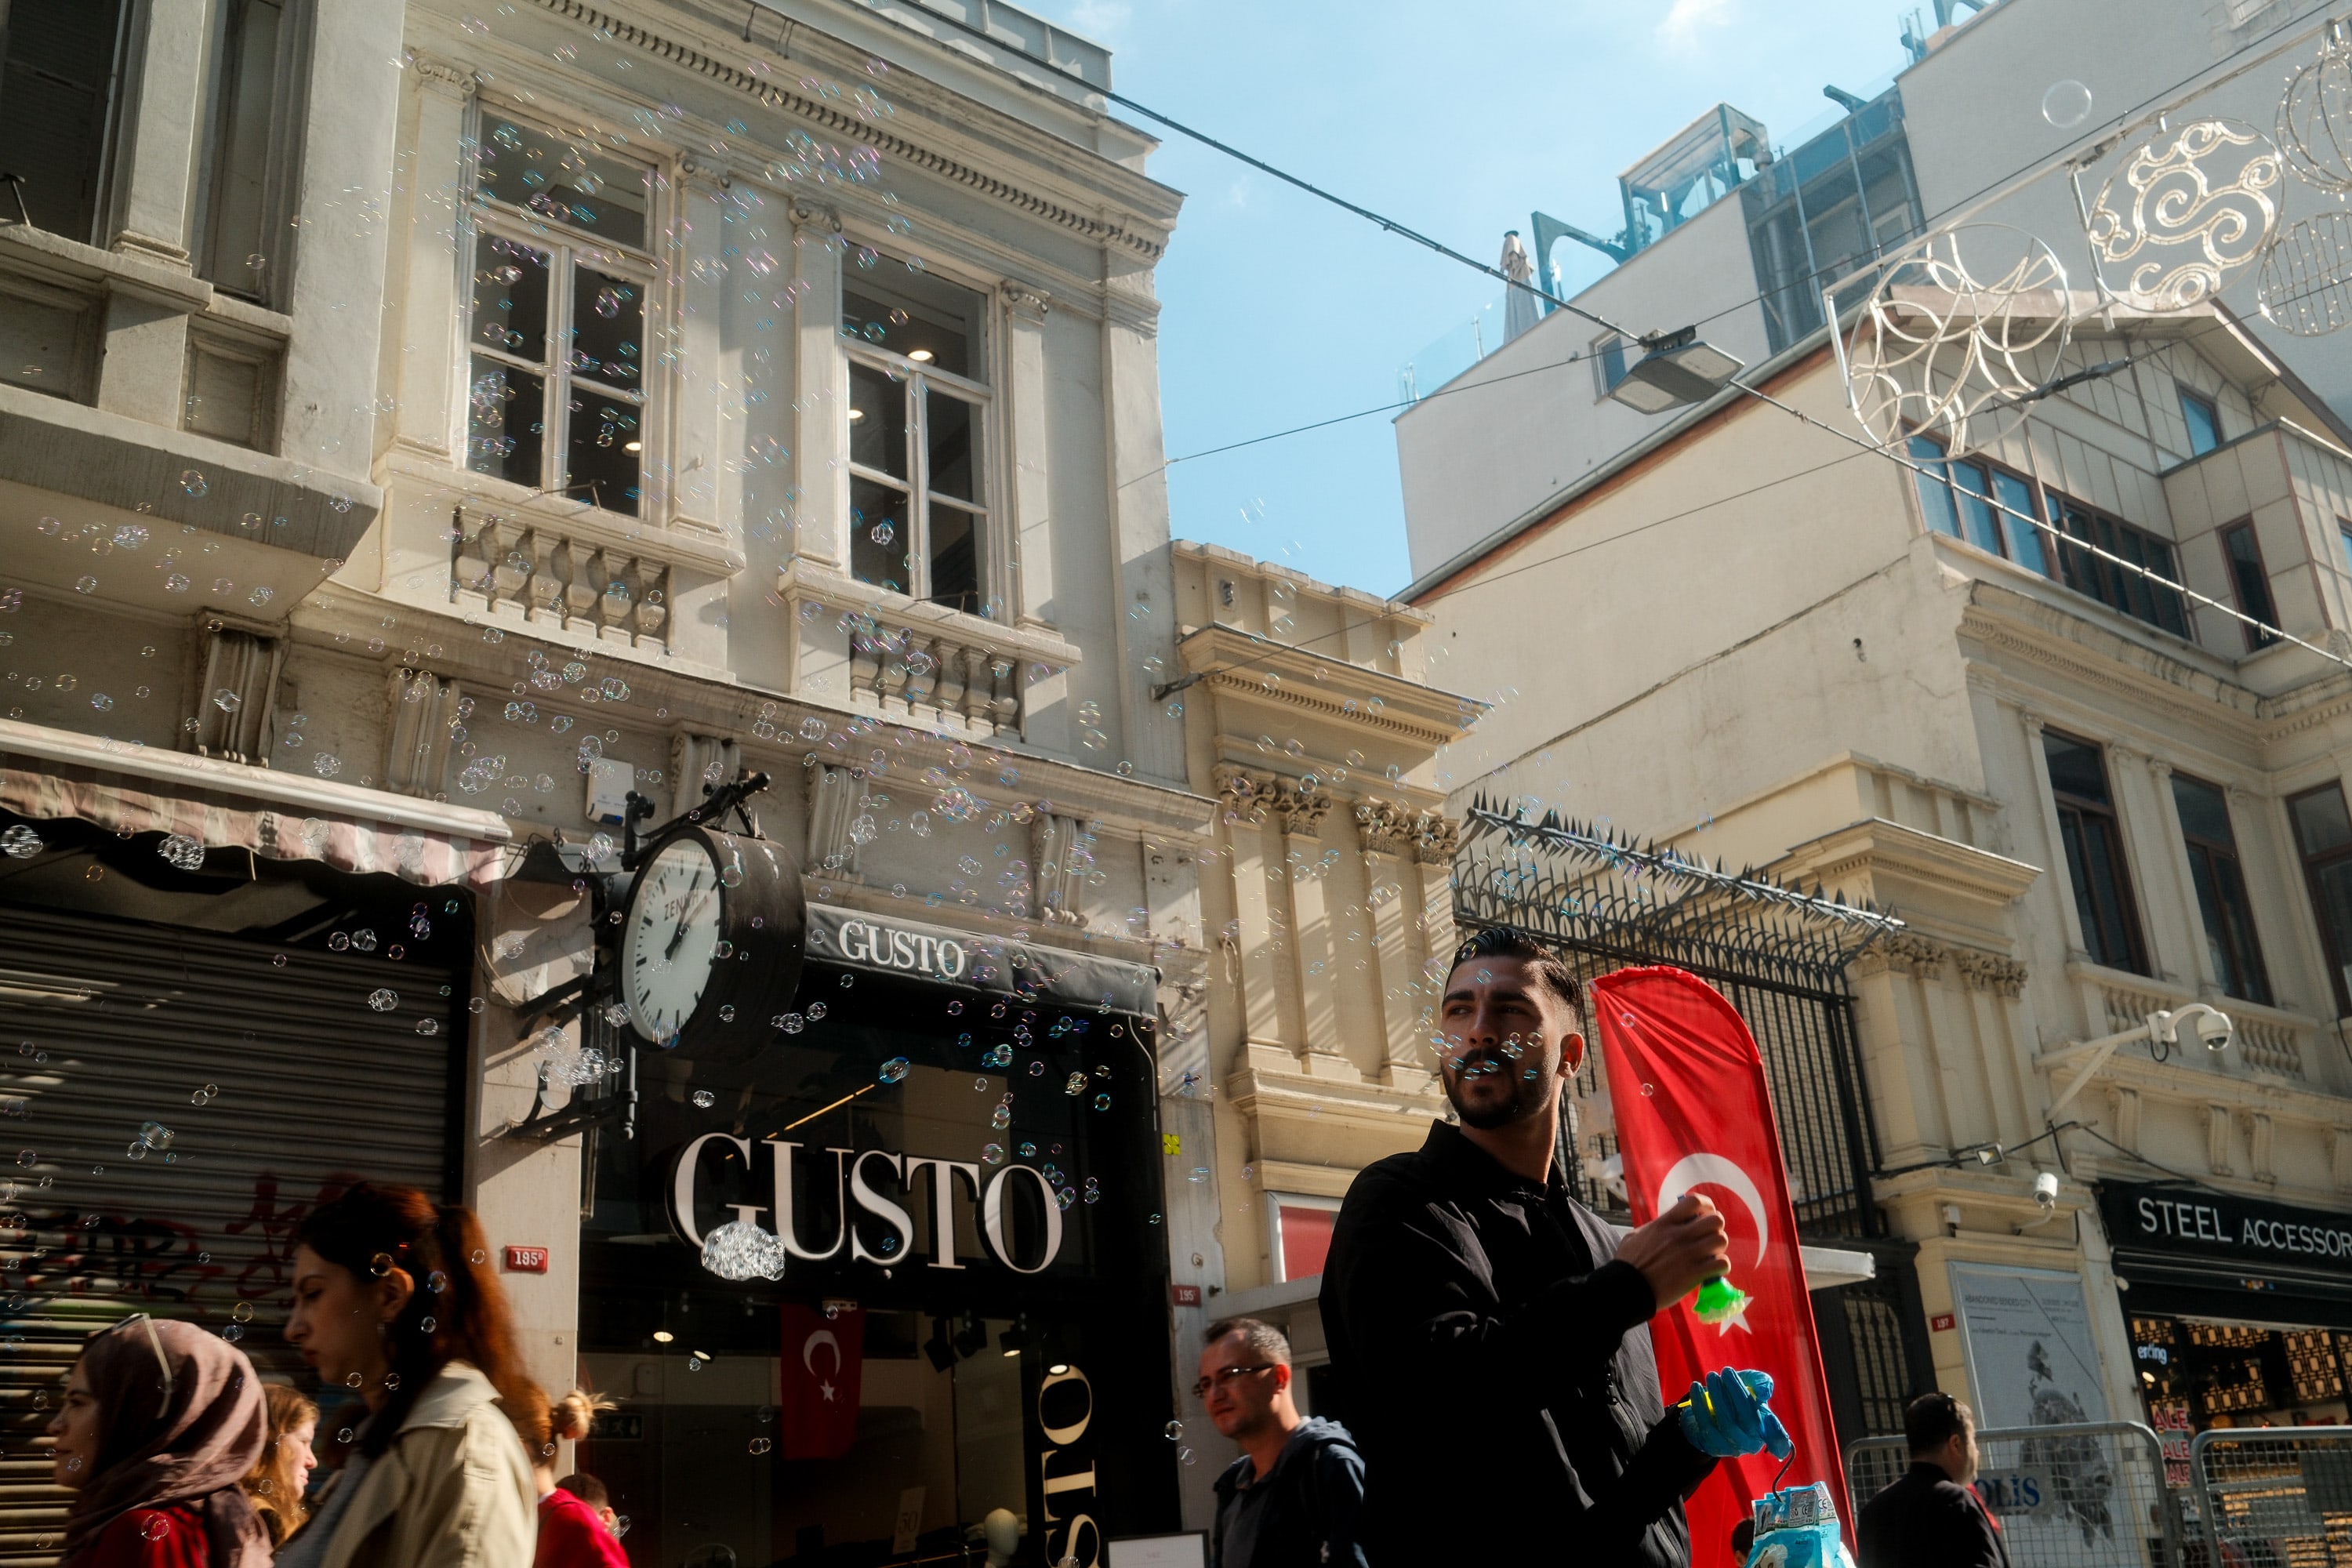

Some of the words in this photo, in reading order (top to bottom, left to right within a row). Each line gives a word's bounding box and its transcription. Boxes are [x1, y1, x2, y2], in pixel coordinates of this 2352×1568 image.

[664, 887, 699, 921] ZENH
[839, 921, 965, 978] GUSTO
[674, 1132, 1063, 1274] GUSTO
[2139, 1197, 2233, 1242] STEEL
[2242, 1218, 2352, 1258] ACCESSOR
